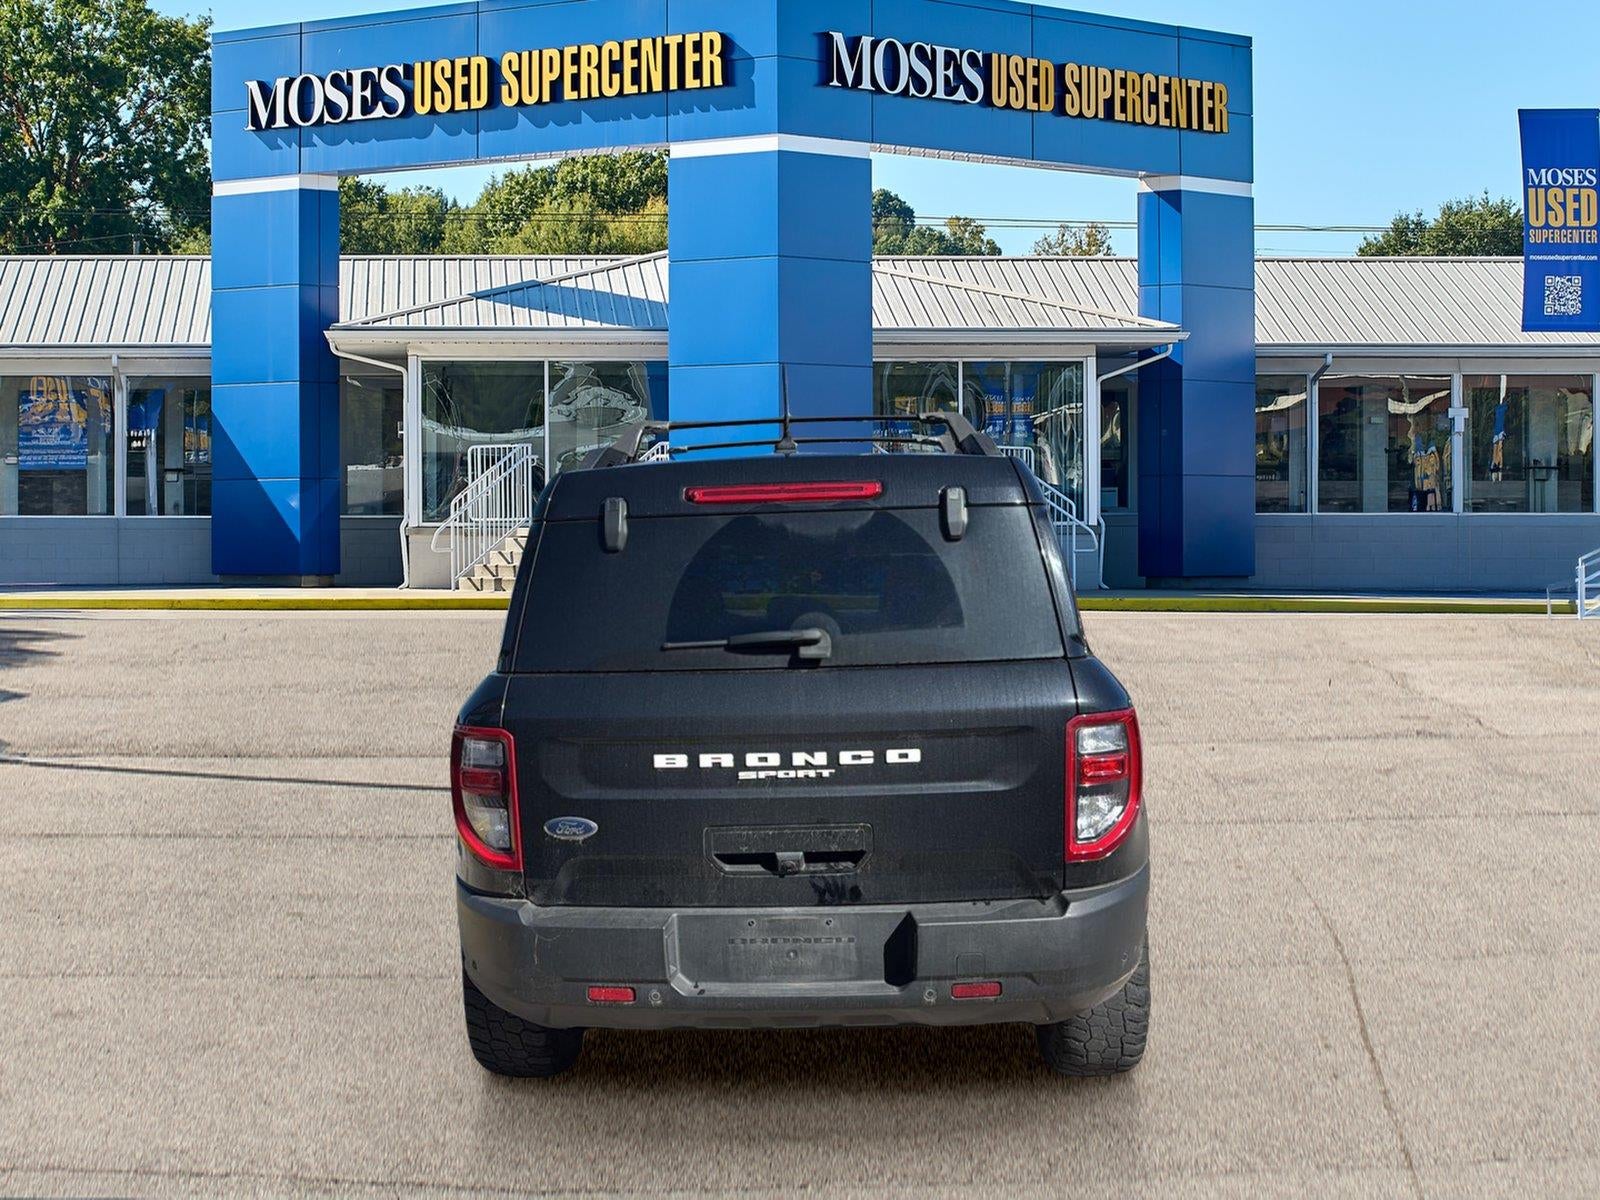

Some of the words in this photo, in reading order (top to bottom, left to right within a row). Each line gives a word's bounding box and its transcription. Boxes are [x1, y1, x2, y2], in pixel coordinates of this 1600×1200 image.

[244, 64, 406, 131] MOSES
[413, 56, 488, 115] USED
[501, 31, 723, 107] SUPERCENTER
[829, 31, 985, 104] MOSES
[991, 52, 1055, 112] USED
[1065, 62, 1229, 133] SUPERCENTER
[1527, 168, 1597, 187] MOSES
[1528, 187, 1598, 227] USED
[1529, 228, 1598, 244] SUPERCENTER
[653, 748, 922, 768] BRONCO
[738, 769, 835, 780] SPORT
